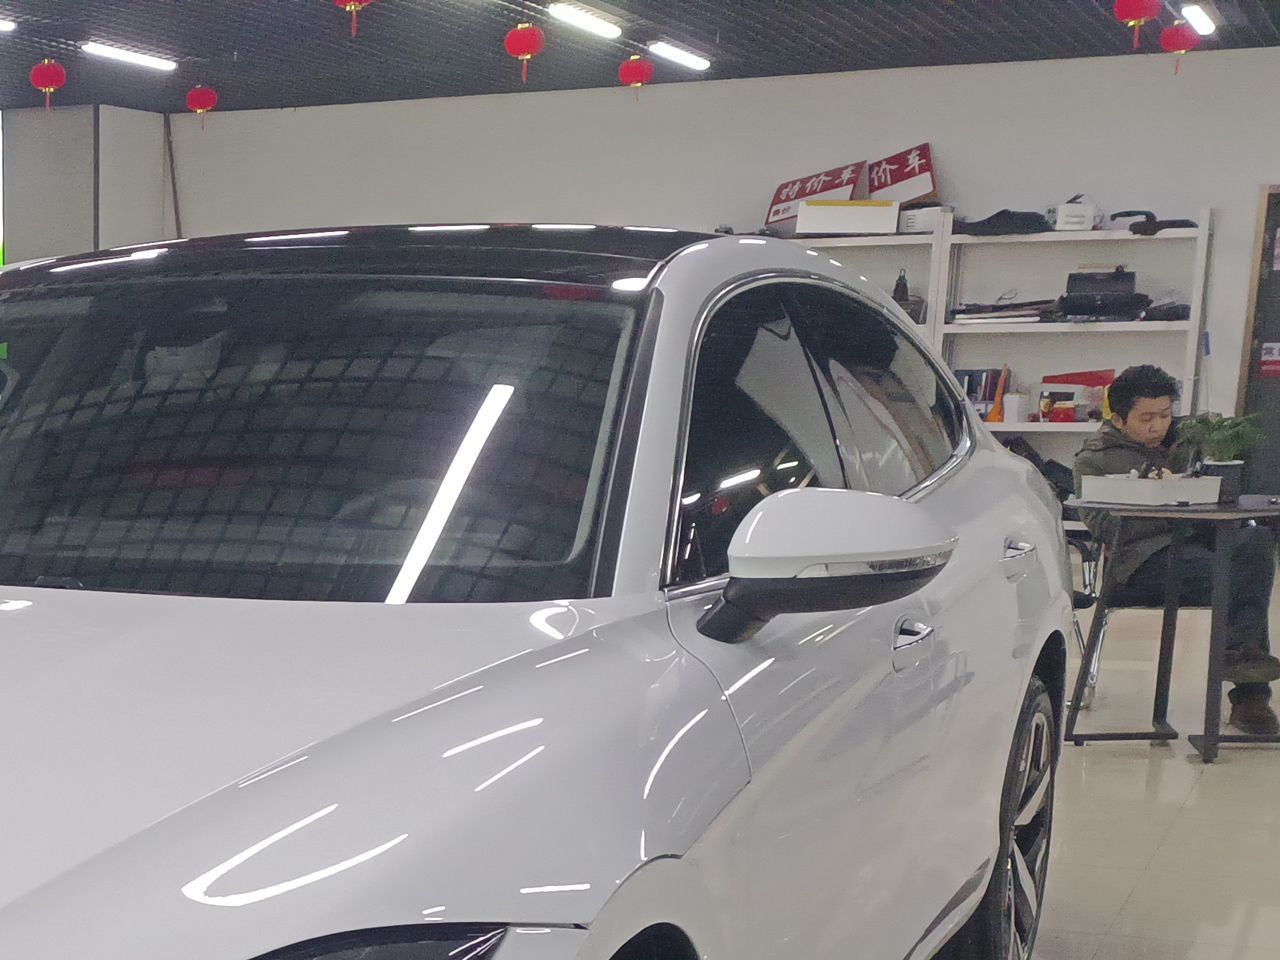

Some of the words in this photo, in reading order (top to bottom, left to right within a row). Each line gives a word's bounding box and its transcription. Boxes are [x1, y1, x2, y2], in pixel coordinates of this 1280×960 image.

[779, 165, 857, 200] 特价车
[871, 149, 926, 186] 价车
